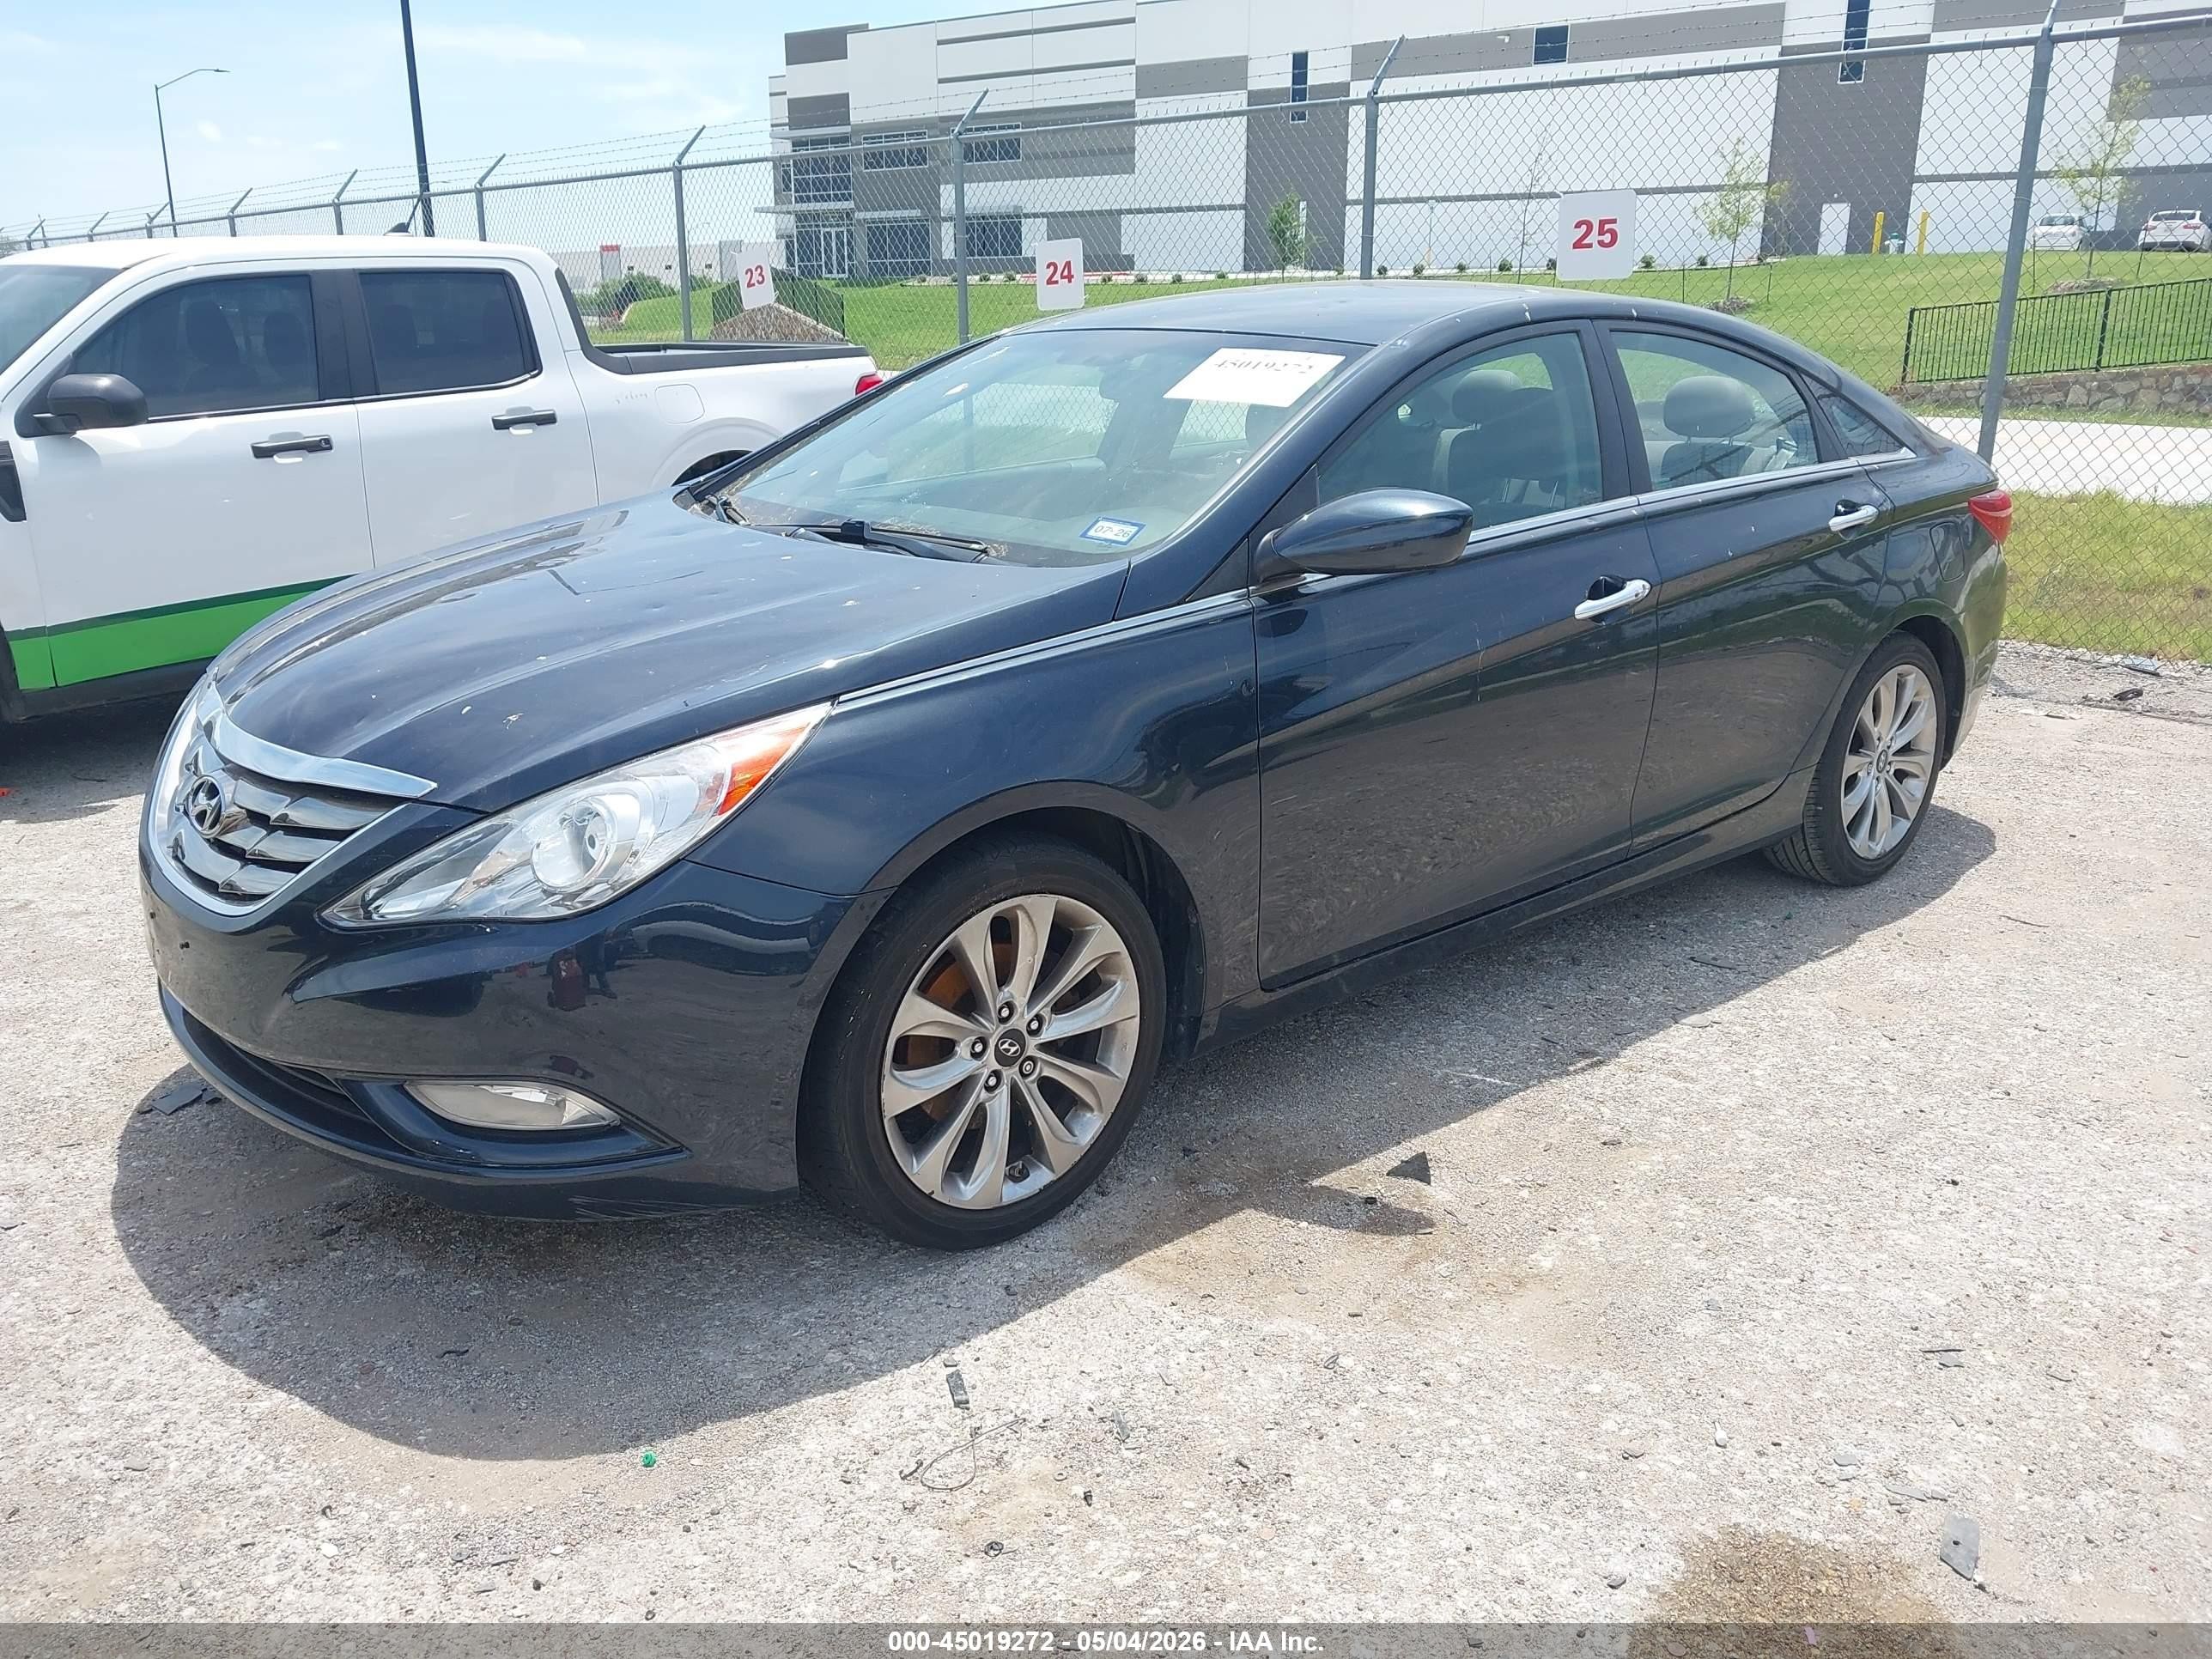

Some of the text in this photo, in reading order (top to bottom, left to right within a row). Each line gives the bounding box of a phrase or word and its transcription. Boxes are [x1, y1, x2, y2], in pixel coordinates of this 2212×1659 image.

[1572, 218, 1619, 249] 25
[744, 264, 765, 288] 23
[1045, 260, 1074, 285] 24
